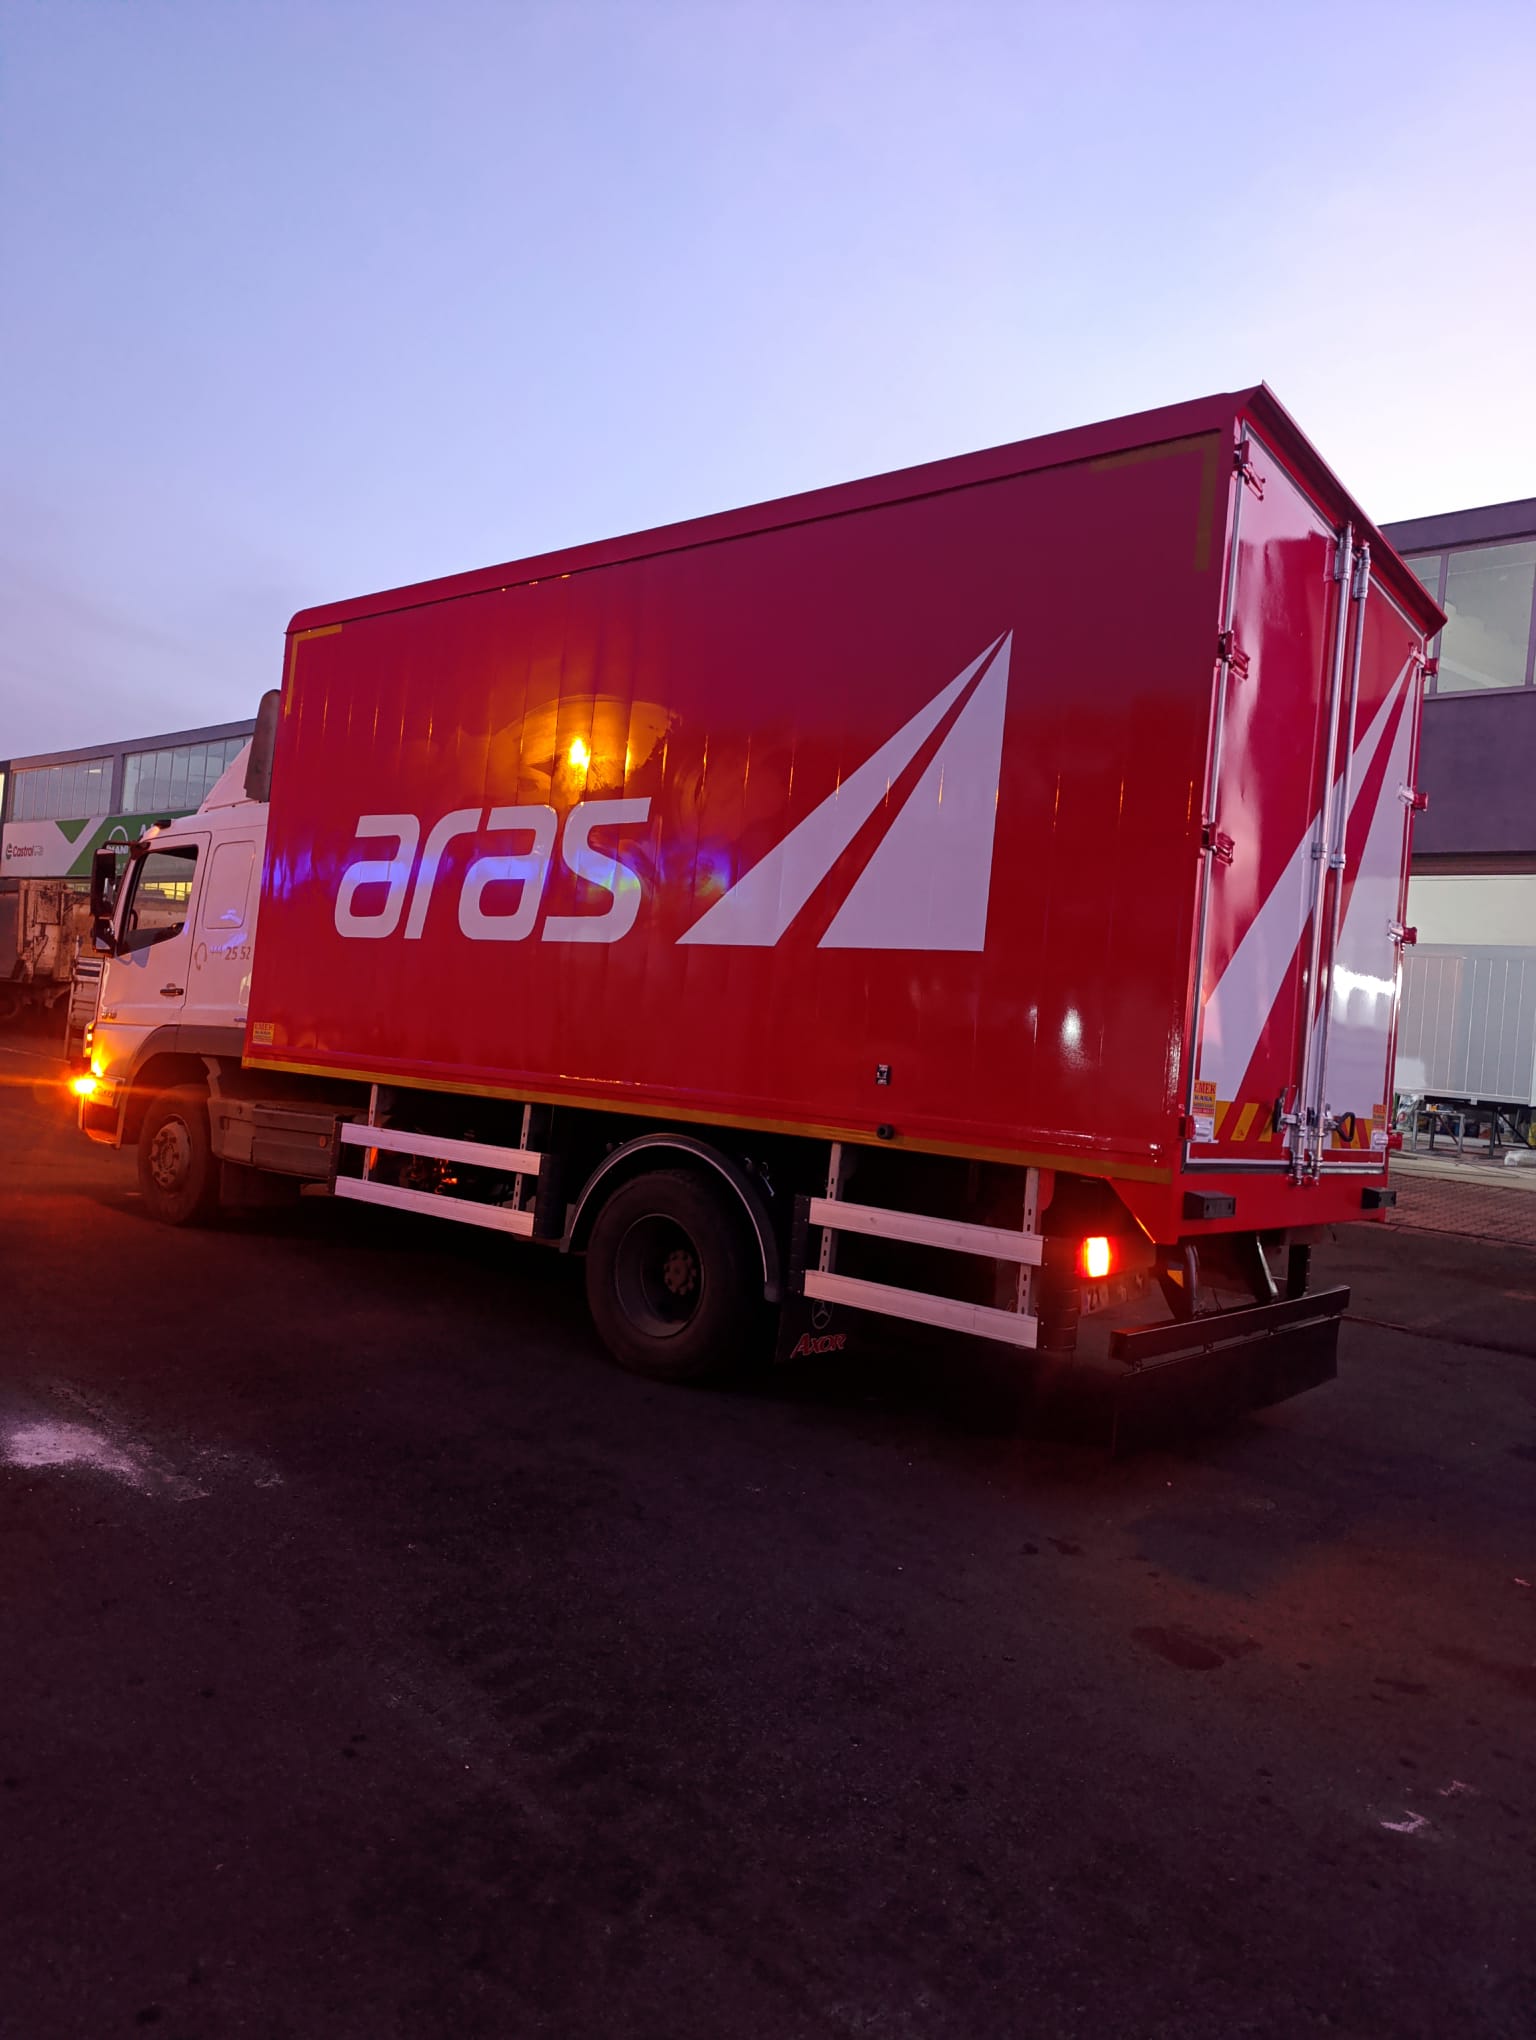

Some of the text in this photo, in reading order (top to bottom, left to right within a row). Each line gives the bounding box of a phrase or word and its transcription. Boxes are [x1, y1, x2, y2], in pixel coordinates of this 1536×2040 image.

[13, 845, 34, 857] Castrol
[335, 797, 651, 943] aras
[225, 946, 238, 960] 25
